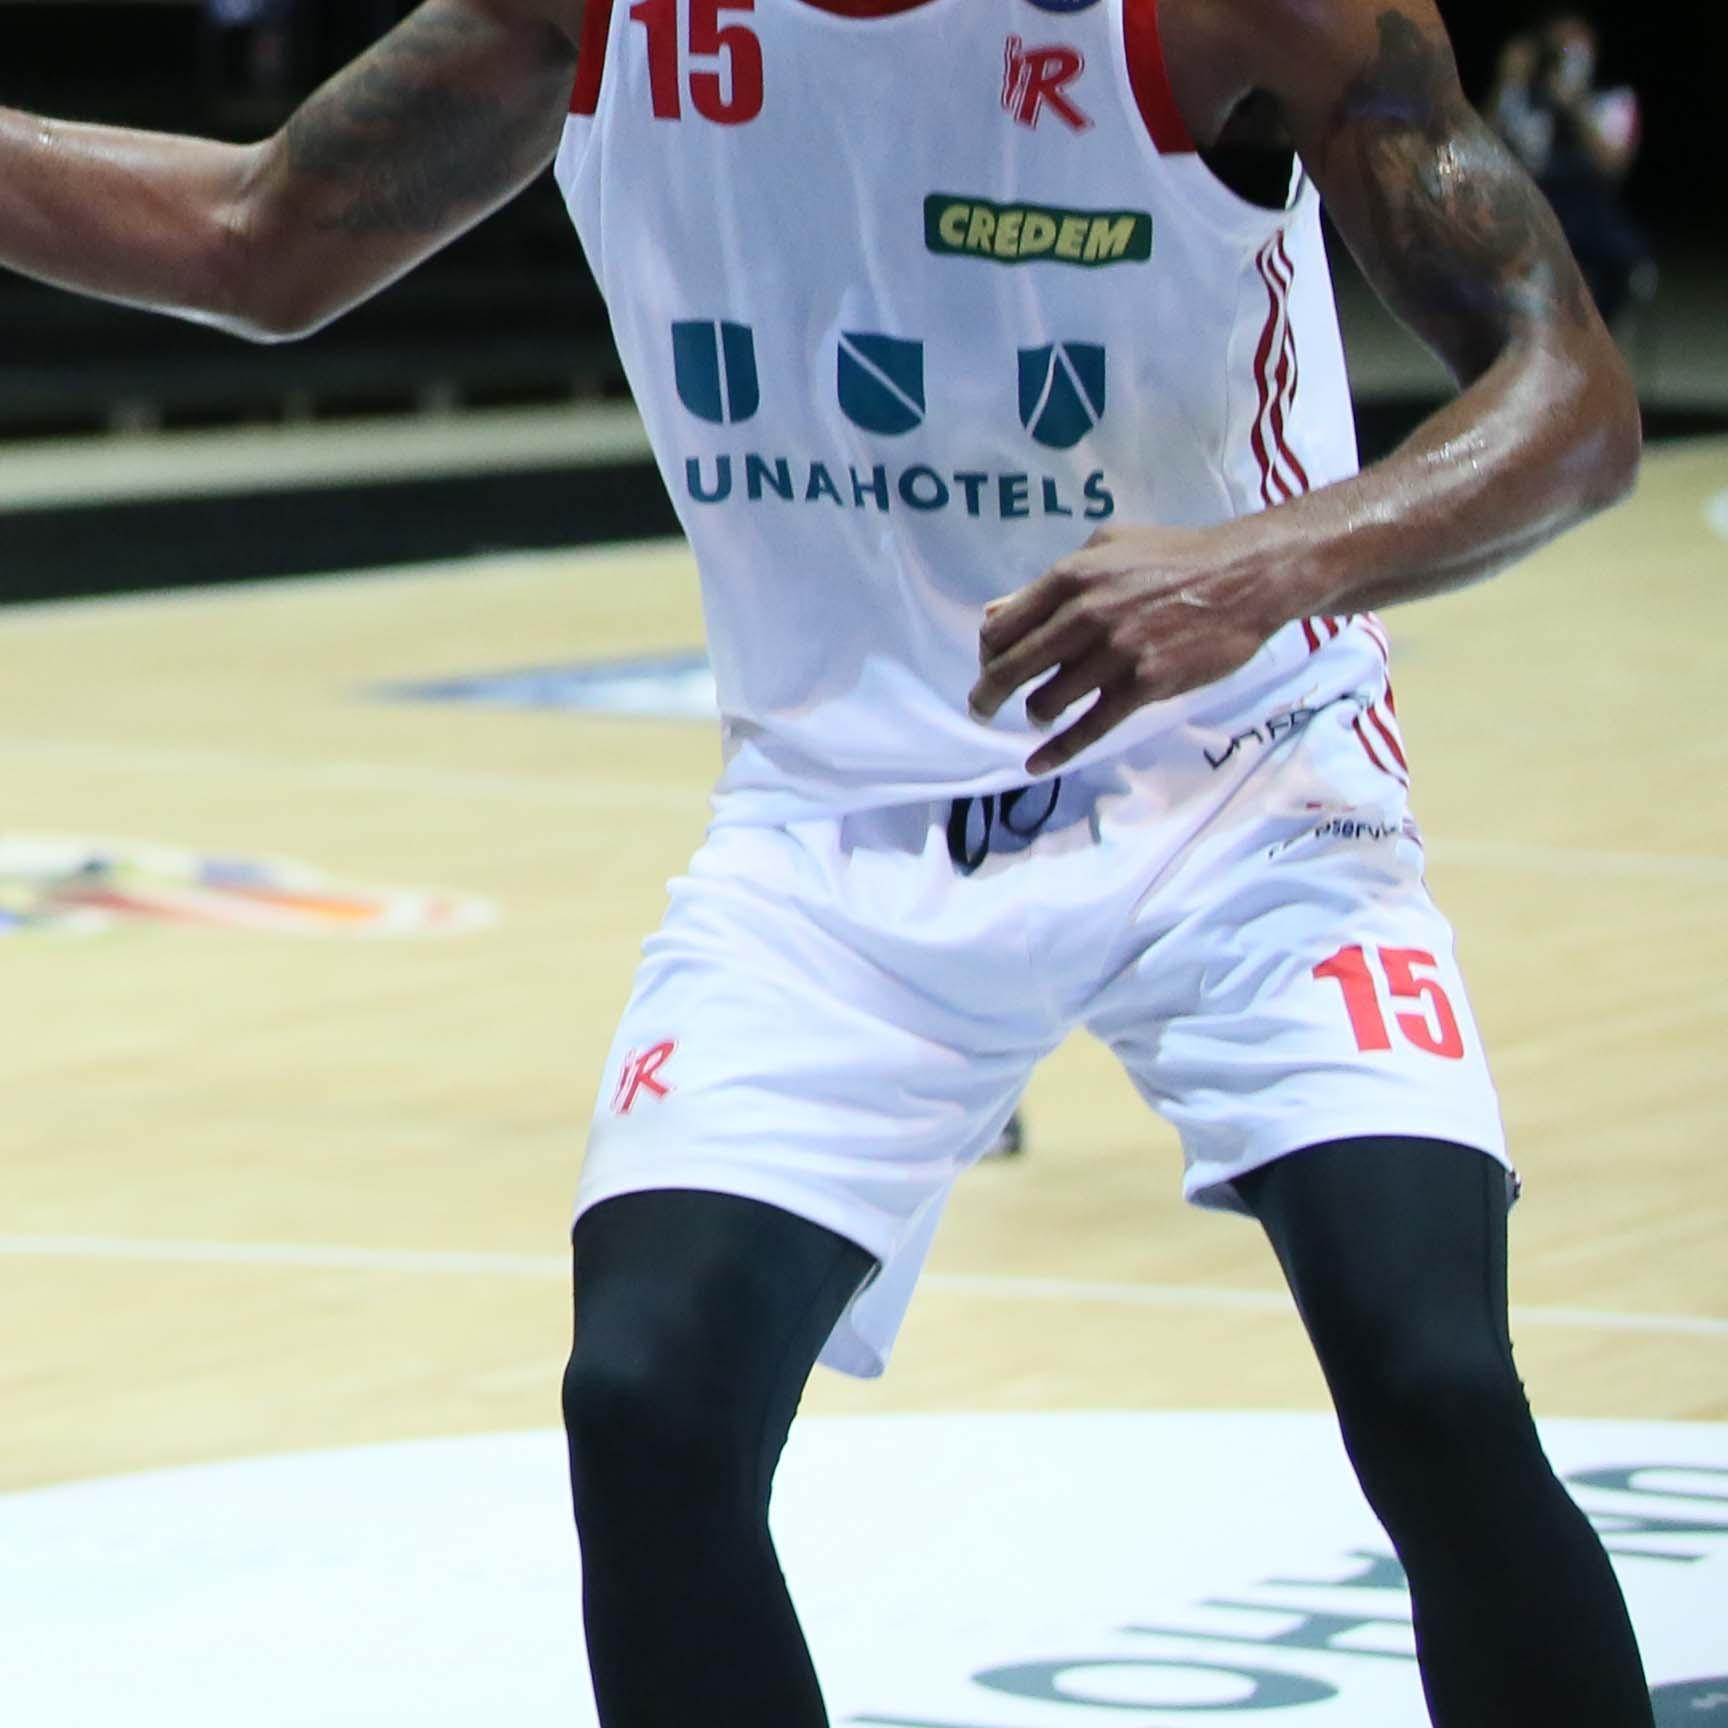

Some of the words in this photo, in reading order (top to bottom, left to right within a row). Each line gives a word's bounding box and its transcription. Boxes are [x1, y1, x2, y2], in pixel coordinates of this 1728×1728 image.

[939, 203, 1137, 262] CREDEM
[686, 454, 1117, 522] UNAHOTELS
[1312, 943, 1466, 1061] 15
